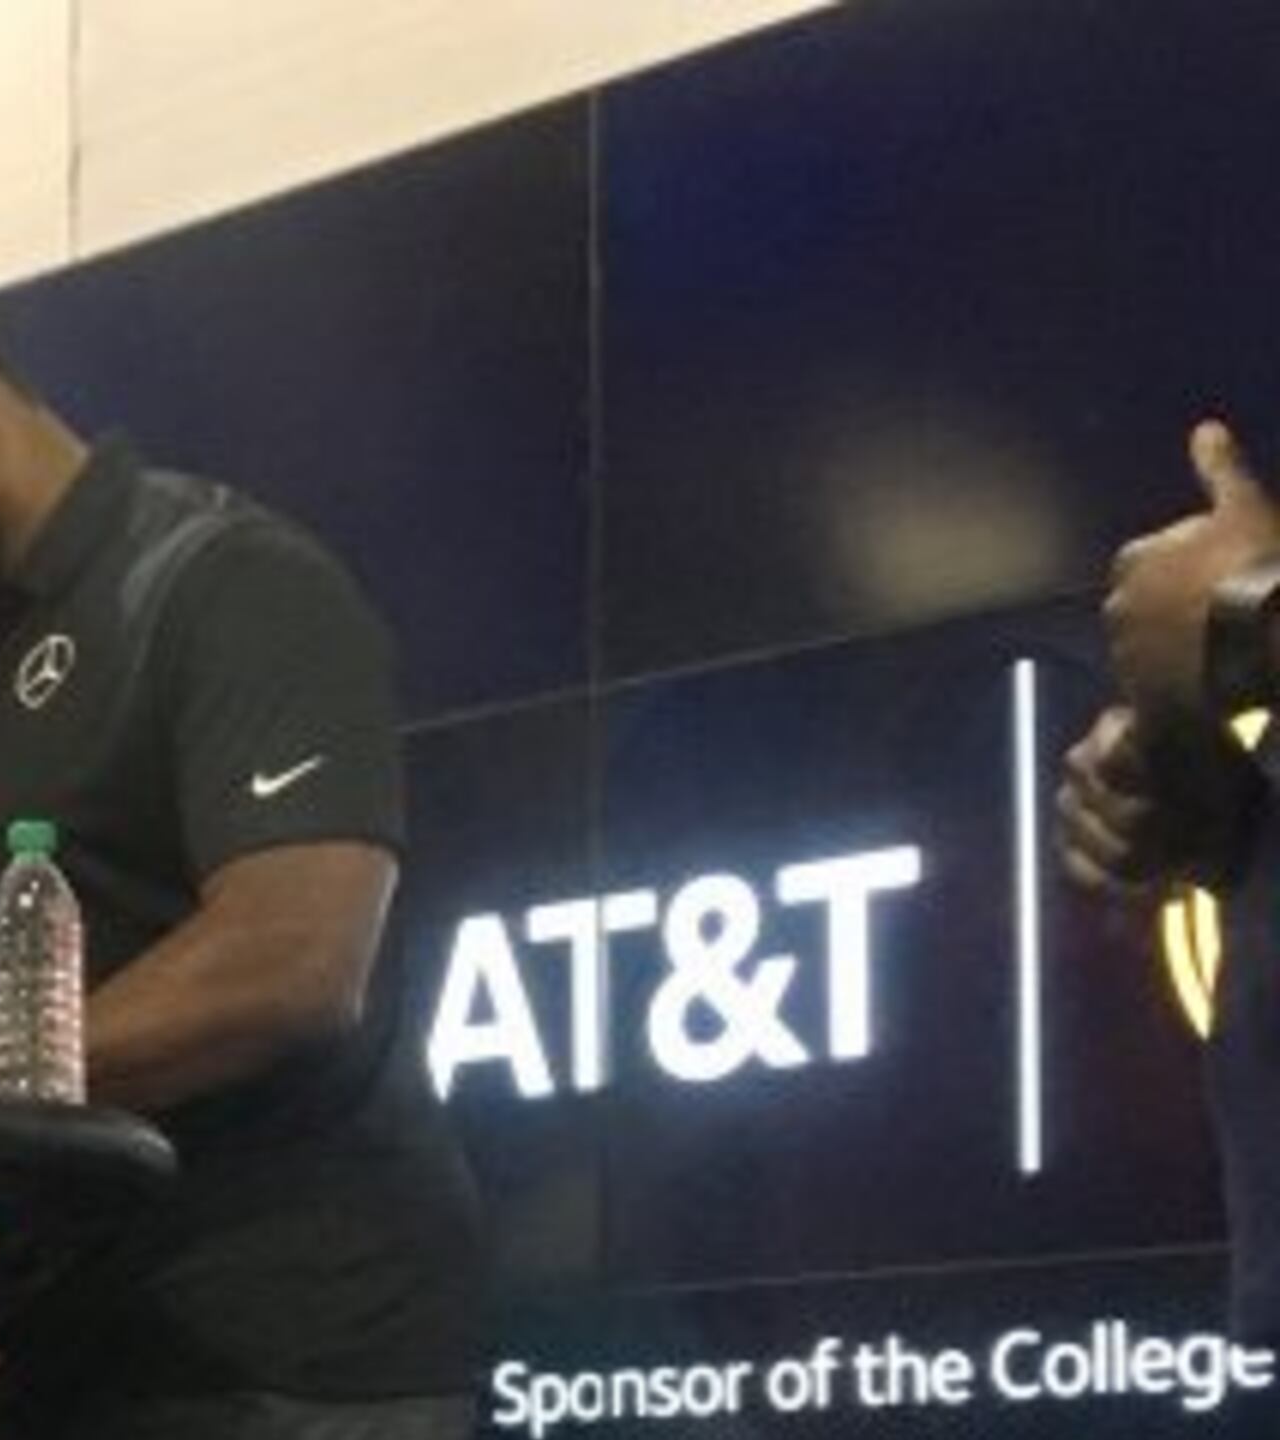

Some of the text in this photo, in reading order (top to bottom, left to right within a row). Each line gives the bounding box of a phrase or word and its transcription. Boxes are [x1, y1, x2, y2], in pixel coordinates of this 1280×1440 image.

[424, 843, 923, 1102] AT&T
[493, 1319, 1276, 1440] Sponsor of the College
